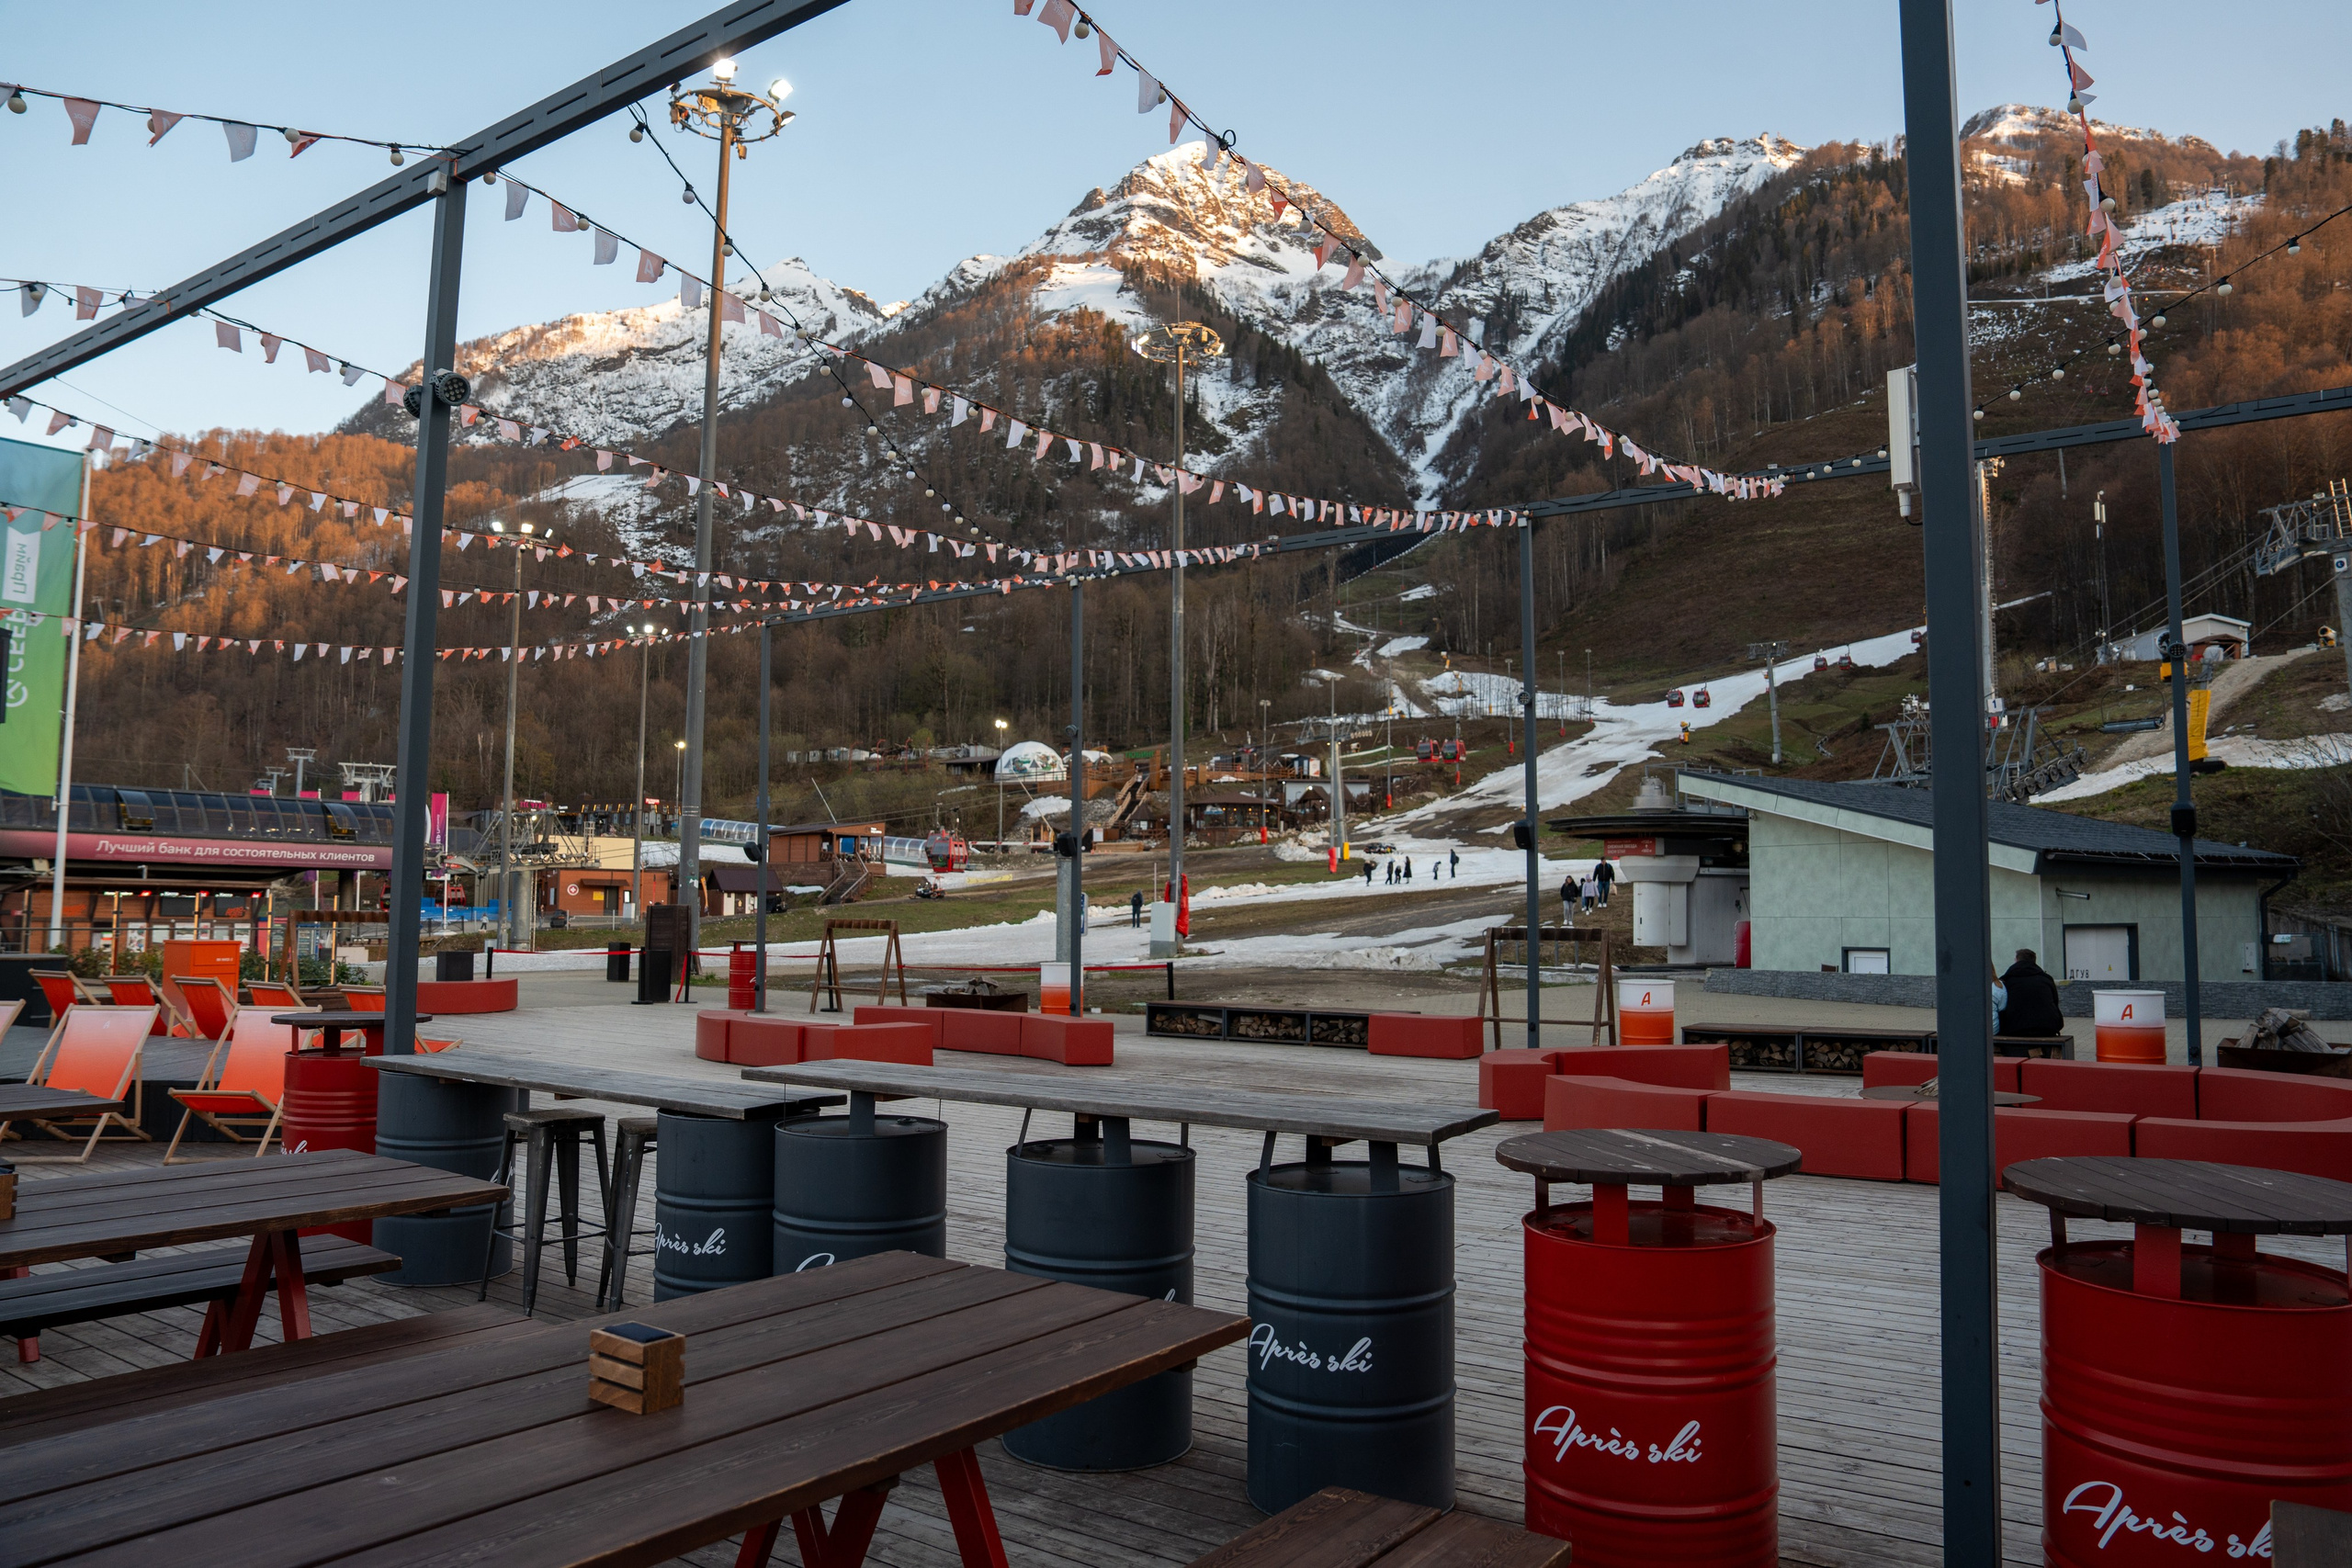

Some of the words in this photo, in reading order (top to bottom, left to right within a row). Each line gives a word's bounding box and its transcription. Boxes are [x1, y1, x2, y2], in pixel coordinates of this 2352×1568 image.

[1992, 700, 1996, 708] 1
[96, 840, 154, 854] Лучший
[158, 842, 191, 854] банк
[194, 847, 220, 856] для
[222, 848, 316, 860] состоятельных
[320, 852, 375, 862] клиентов
[1641, 991, 1651, 1006] A
[2120, 1003, 2133, 1021] A
[654, 1222, 689, 1259] Après
[694, 1227, 726, 1256] ski
[1249, 1323, 1321, 1371] Après
[1327, 1337, 1373, 1372] ski
[1533, 1405, 1639, 1462] Après
[1647, 1420, 1702, 1463] ski
[2063, 1481, 2214, 1552] Après
[2226, 1517, 2272, 1559] sk
